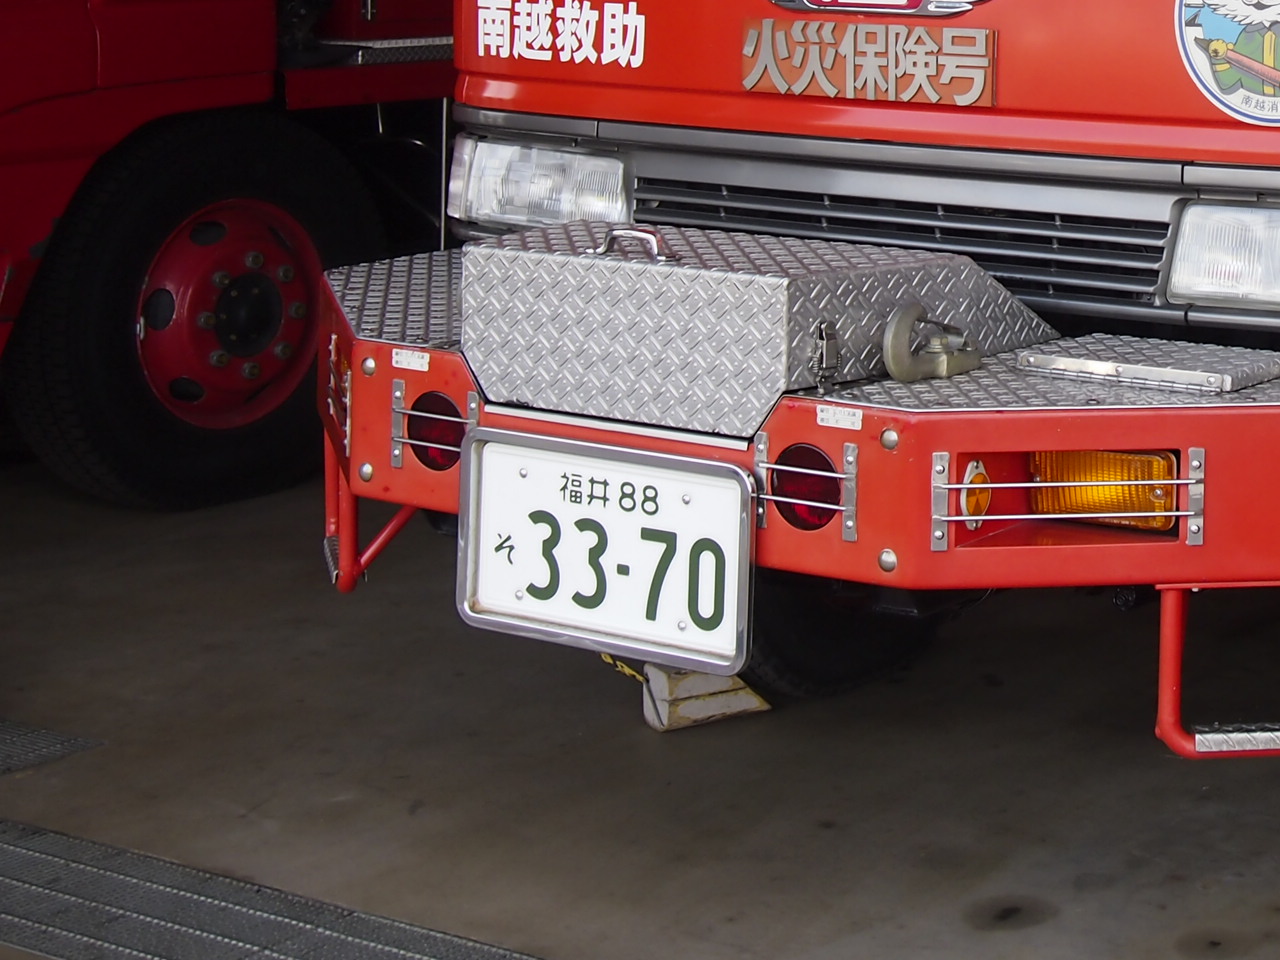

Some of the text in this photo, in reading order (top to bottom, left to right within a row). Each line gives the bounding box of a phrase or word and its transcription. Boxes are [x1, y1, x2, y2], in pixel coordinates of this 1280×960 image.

[742, 18, 990, 107] 火災保険号
[494, 509, 727, 632] そ 33-70
